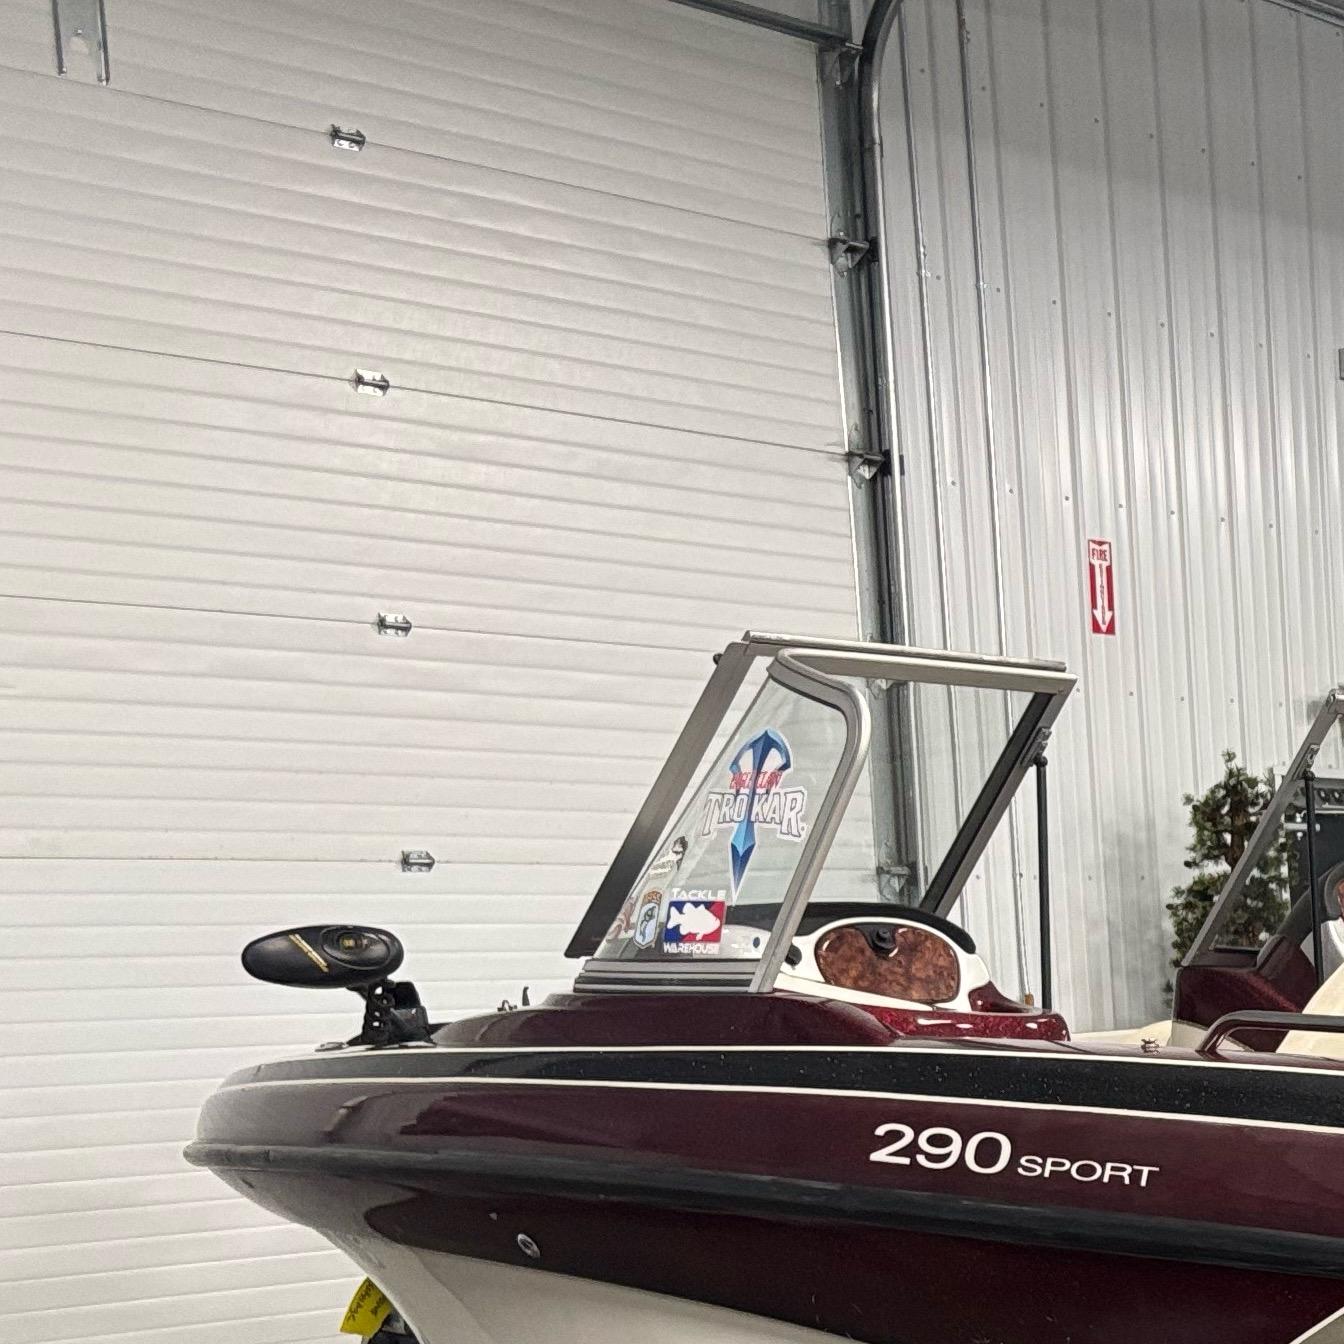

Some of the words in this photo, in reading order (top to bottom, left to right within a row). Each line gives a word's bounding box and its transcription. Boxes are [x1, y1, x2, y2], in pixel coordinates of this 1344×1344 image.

[1091, 548, 1108, 561] FIRE
[701, 788, 802, 837] TROKAR
[671, 887, 727, 900] TACKLE
[663, 942, 720, 955] WAREHOUSE
[868, 1122, 1012, 1175] 290
[1017, 1155, 1160, 1188] SPORT
